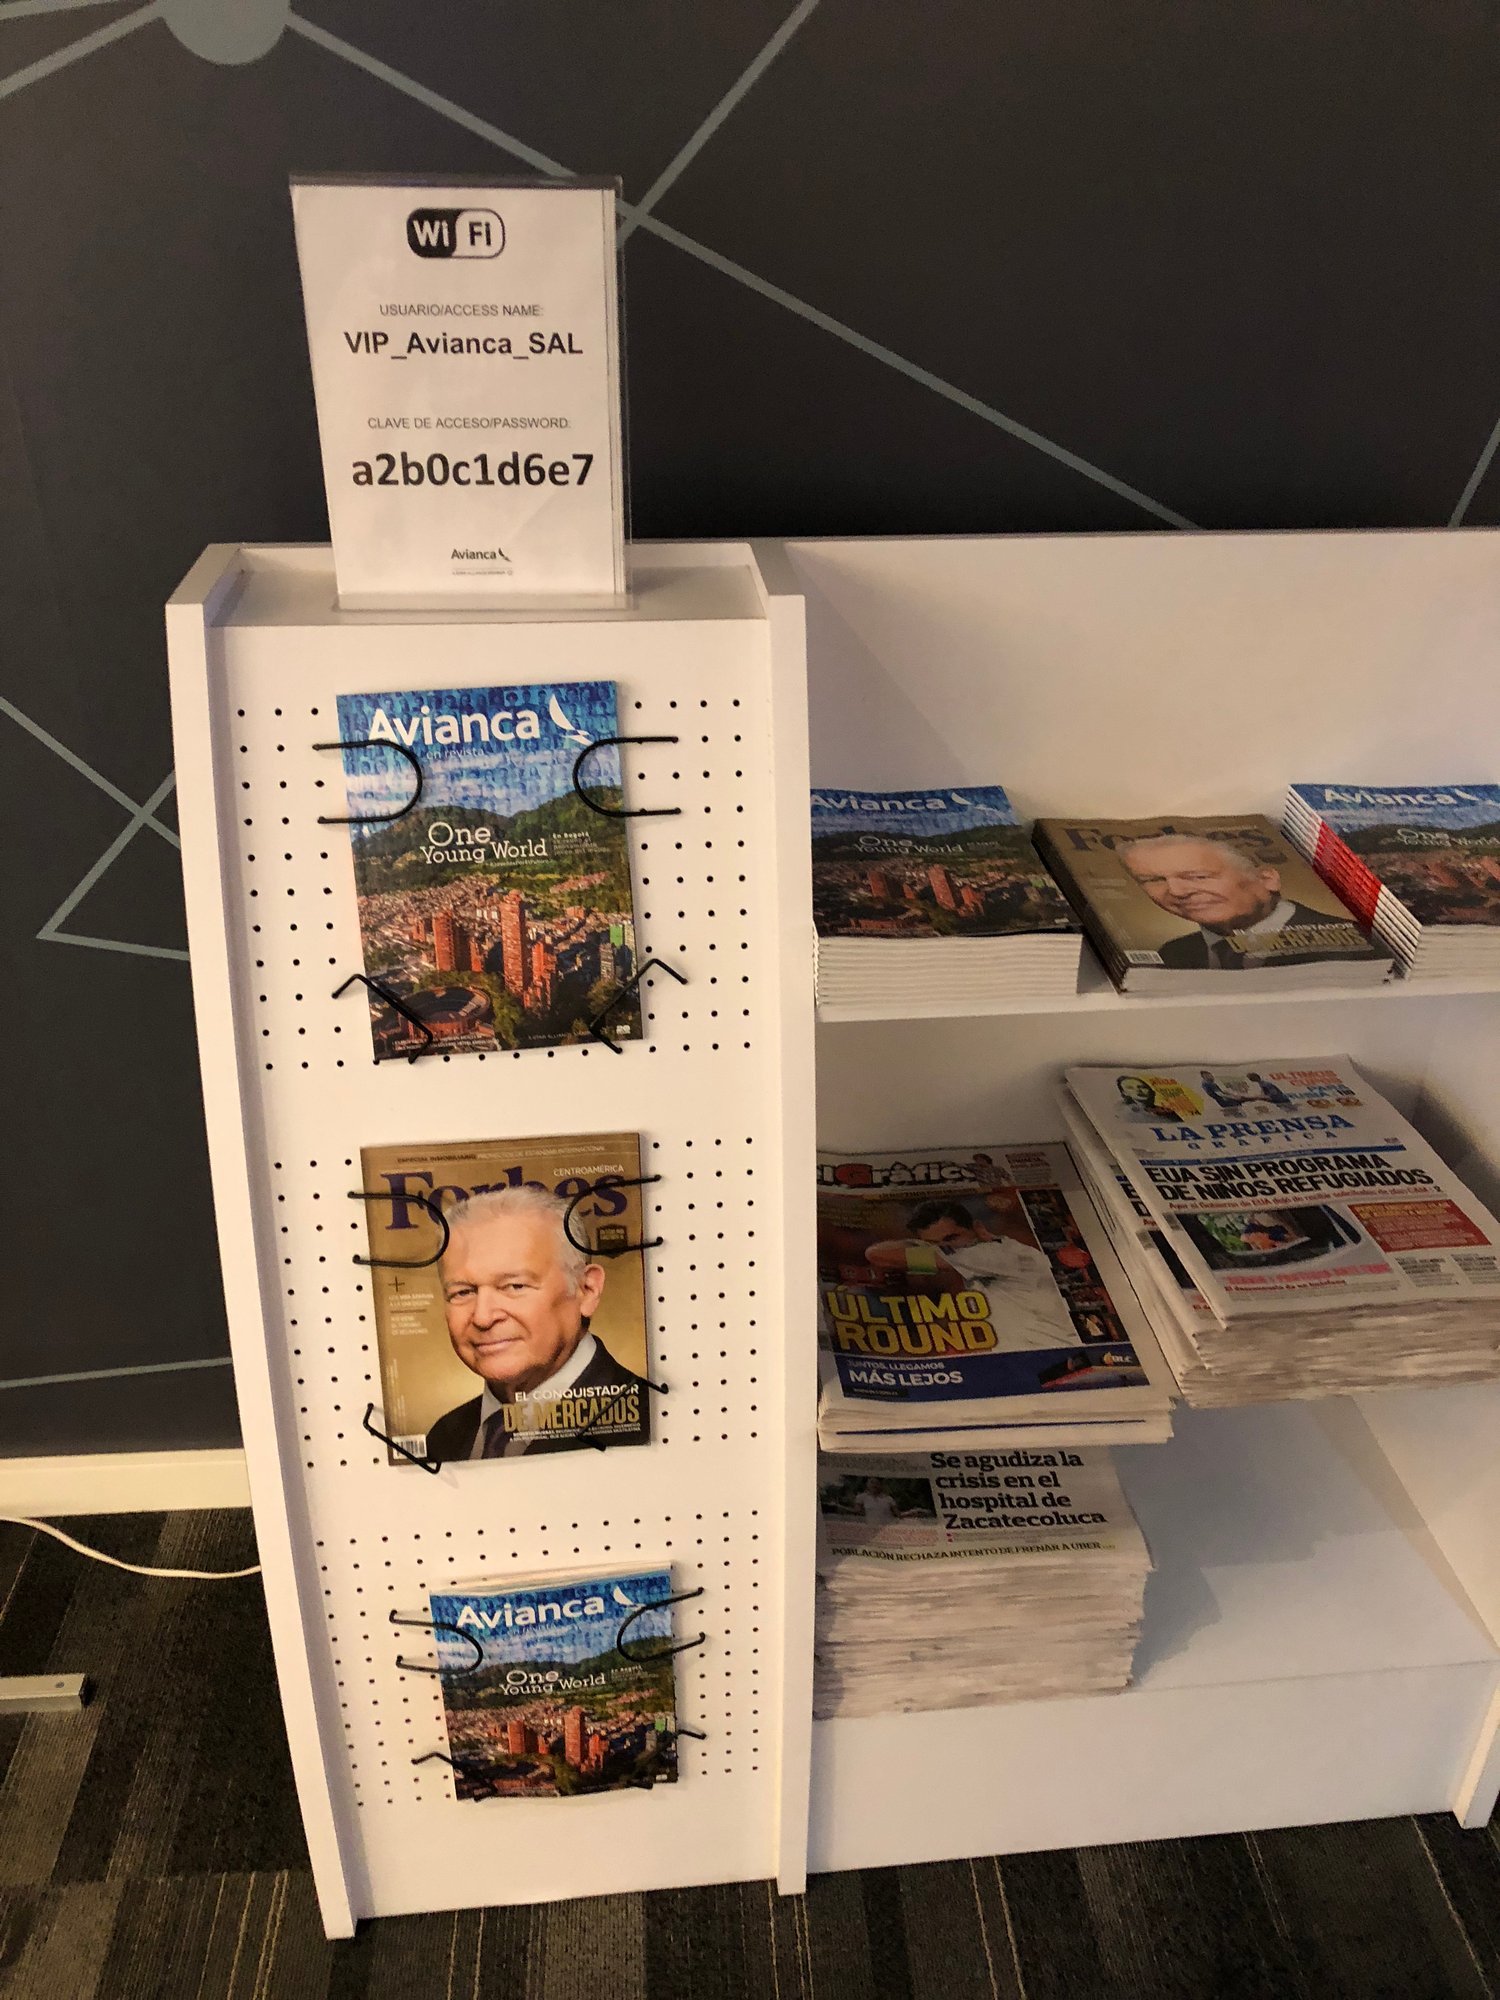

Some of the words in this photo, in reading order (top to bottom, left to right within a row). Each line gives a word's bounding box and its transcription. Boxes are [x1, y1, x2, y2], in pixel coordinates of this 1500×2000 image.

[380, 304, 499, 317] USUARIO/ACCESS
[502, 304, 544, 317] NAME:
[344, 331, 583, 360] VIP_Avianca_SAL
[368, 418, 410, 430] CLAVE
[414, 418, 431, 430] DE
[351, 451, 594, 487] a2b0c1d6e7
[450, 548, 497, 561] Avianca
[368, 705, 540, 747] Avianca
[811, 792, 947, 812] Avianca
[1325, 787, 1458, 805] Avianca
[428, 821, 492, 847] One
[420, 846, 486, 865] Young
[492, 839, 548, 861] World
[1151, 1126, 1205, 1142] LA
[1204, 1113, 1356, 1140] PRENSA
[554, 1164, 624, 1177] CENTROAMÉRICA
[1145, 1165, 1197, 1183] EUA
[1198, 1161, 1244, 1182] SIN
[1243, 1154, 1393, 1179] PROGRAMA
[1158, 1184, 1191, 1202] DE
[1189, 1177, 1276, 1200] NIÑOS
[1274, 1168, 1434, 1195] REFUGIADOS
[381, 1166, 628, 1230] Foes
[828, 1285, 991, 1325] ÚLTIMO
[836, 1320, 998, 1353] ROUND
[849, 1368, 896, 1385] MÁS
[898, 1371, 964, 1387] LEJOS
[889, 1361, 945, 1372] LLEGAMOS
[515, 1389, 530, 1402] EL
[534, 1395, 640, 1431] MERCADOS
[931, 1452, 960, 1469] Se
[965, 1451, 1058, 1472] agudiza
[1061, 1451, 1084, 1468] la
[935, 1471, 1001, 1489] crisis
[1004, 1473, 1035, 1488] en
[1038, 1471, 1061, 1488] el
[939, 1491, 1038, 1514] hospital
[1042, 1491, 1072, 1508] de
[943, 1510, 1107, 1531] Zacatecoluca
[895, 1551, 949, 1562] RECHAZA
[950, 1546, 1000, 1558] INTENTO
[999, 1545, 1015, 1554] DE
[456, 1594, 605, 1630] Avianca
[499, 1683, 553, 1697] Young
[559, 1673, 607, 1690] World
[506, 1670, 559, 1686] One
